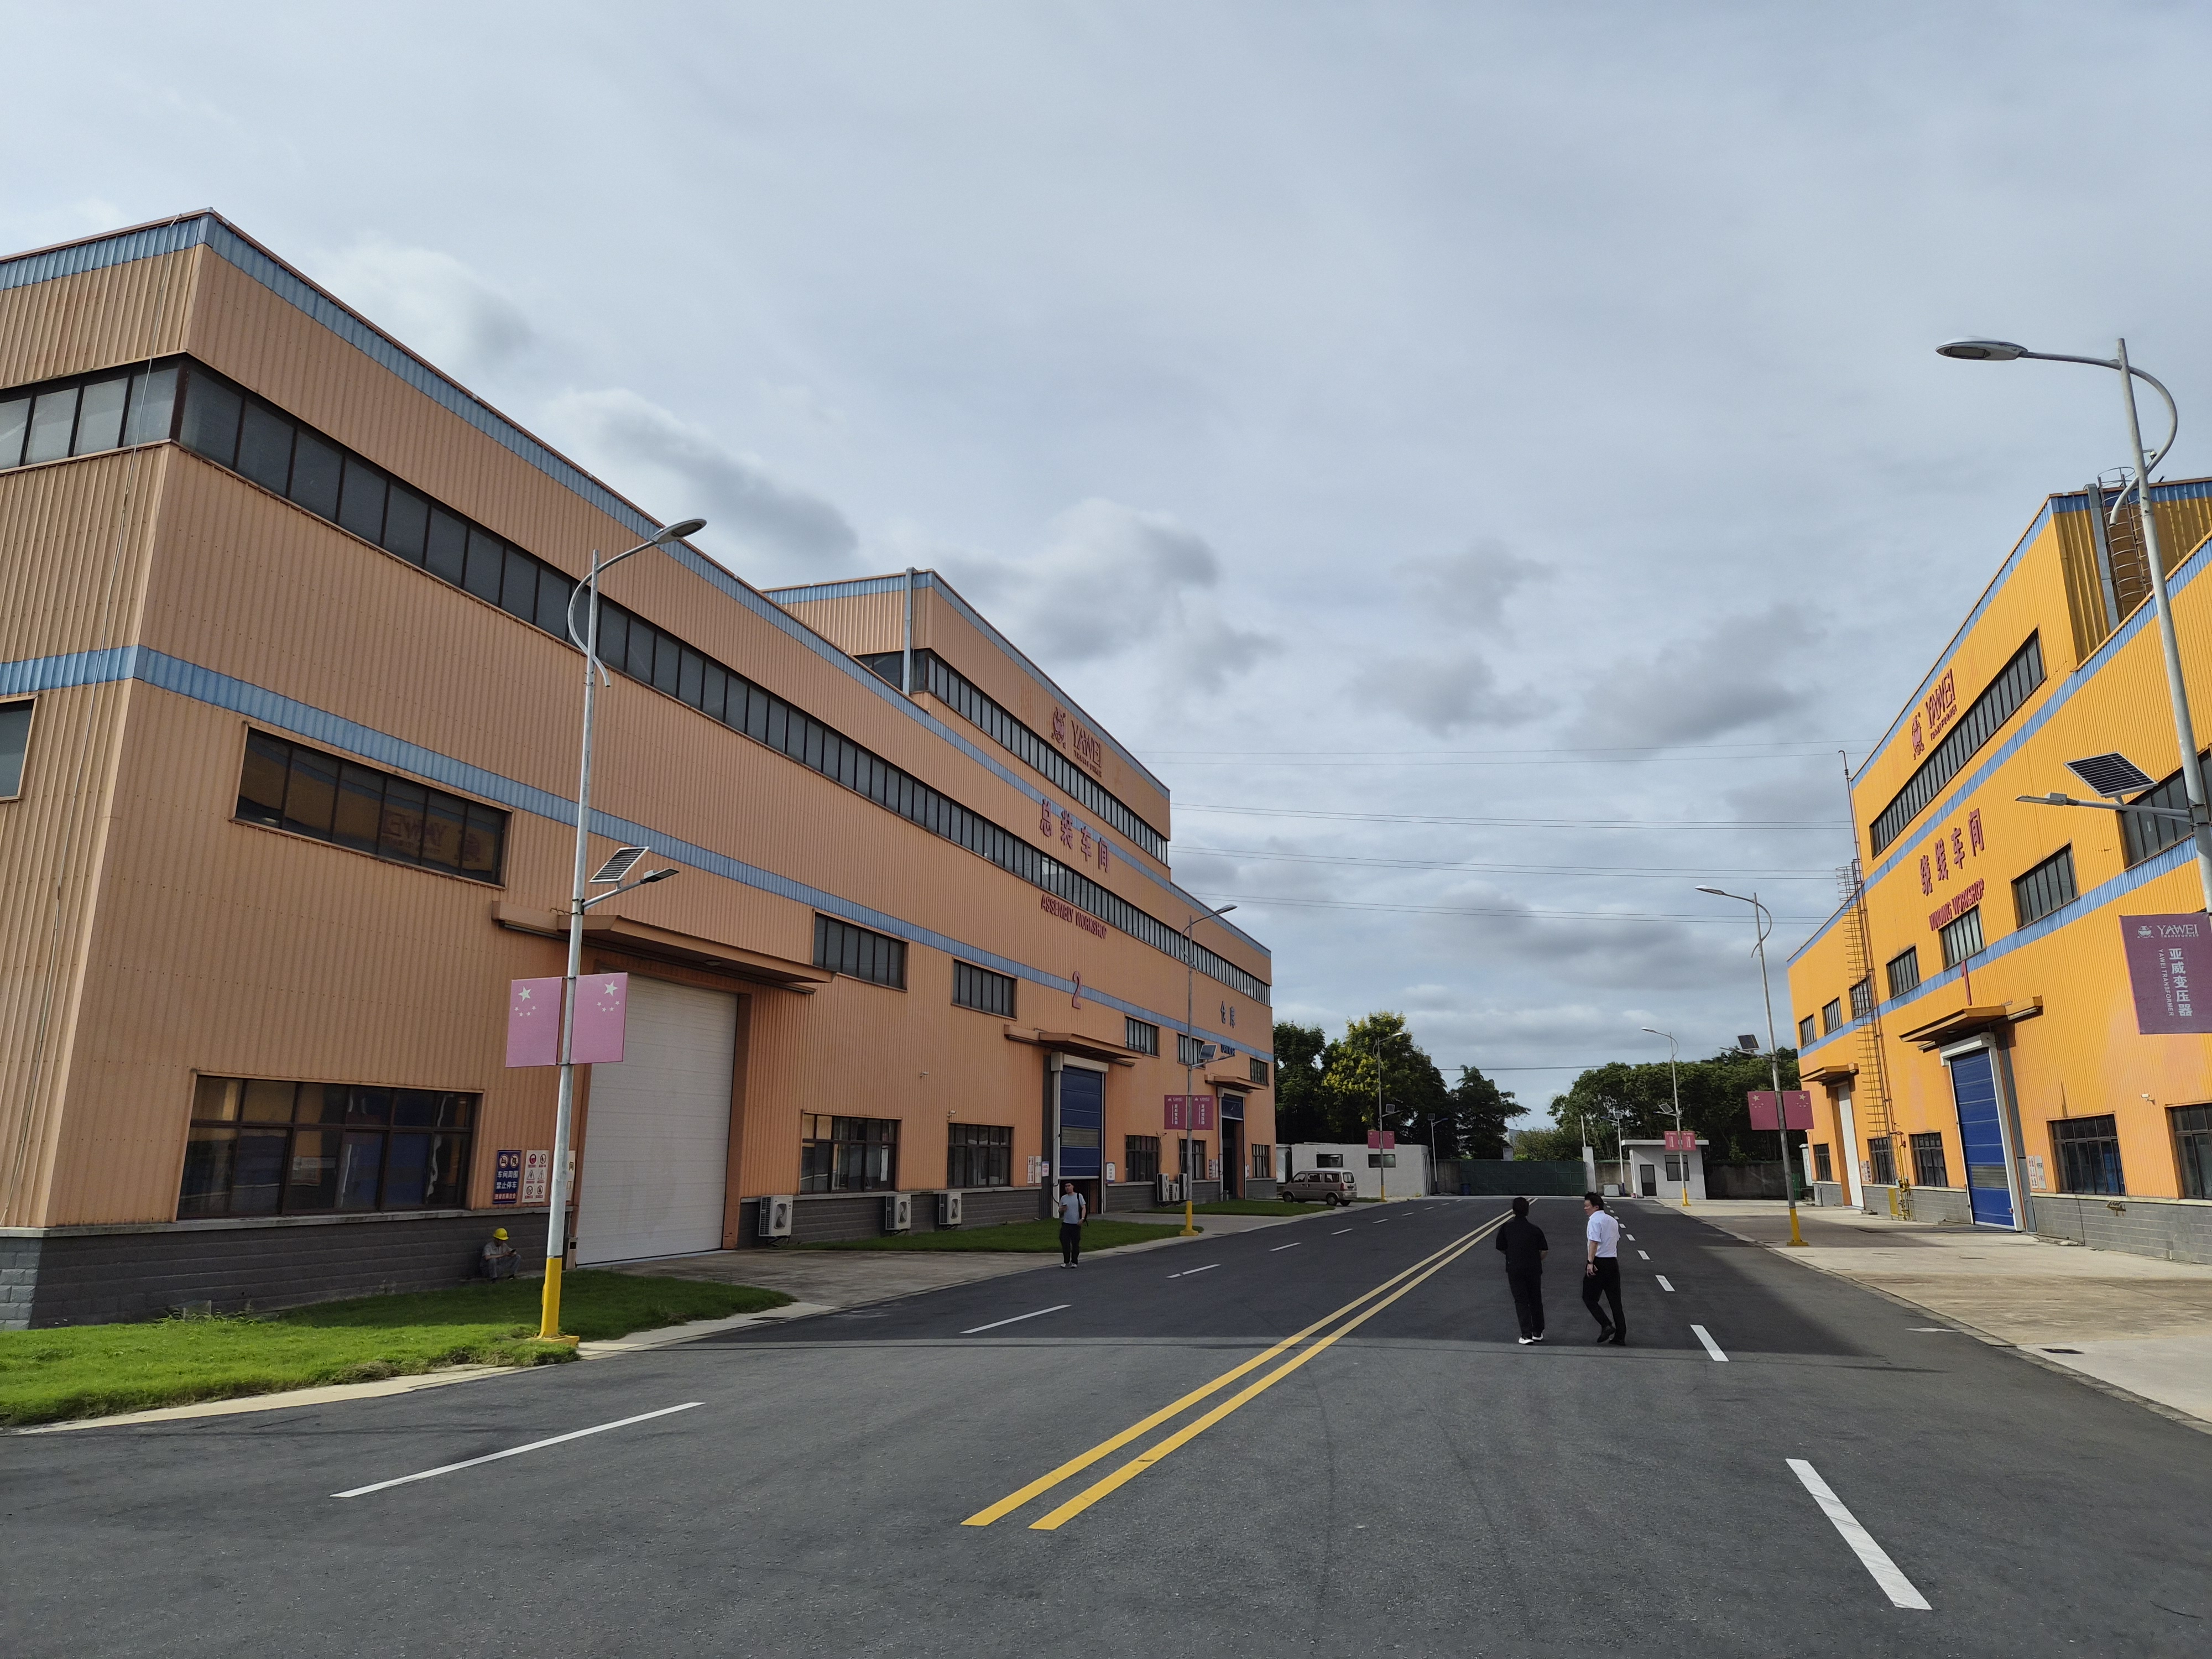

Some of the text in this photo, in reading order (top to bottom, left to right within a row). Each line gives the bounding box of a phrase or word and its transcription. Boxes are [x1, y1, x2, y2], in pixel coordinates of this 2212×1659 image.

[1925, 668, 1955, 729] YAWEI
[1071, 720, 1101, 768] YAWEI
[1040, 799, 1110, 873] 总装车间
[1920, 808, 1985, 896] 绕线车间
[1041, 894, 1107, 939] ASSEMBLY WORKSHOP
[1929, 878, 1985, 931] WINDING WORKSHOP
[2157, 924, 2199, 935] YAWEI
[1072, 971, 1082, 1010] 2
[1961, 960, 1972, 1006] 1
[2168, 948, 2193, 1016] 亚威变压器
[1220, 1001, 1235, 1029] 仓库
[498, 1170, 518, 1178] 车间周围
